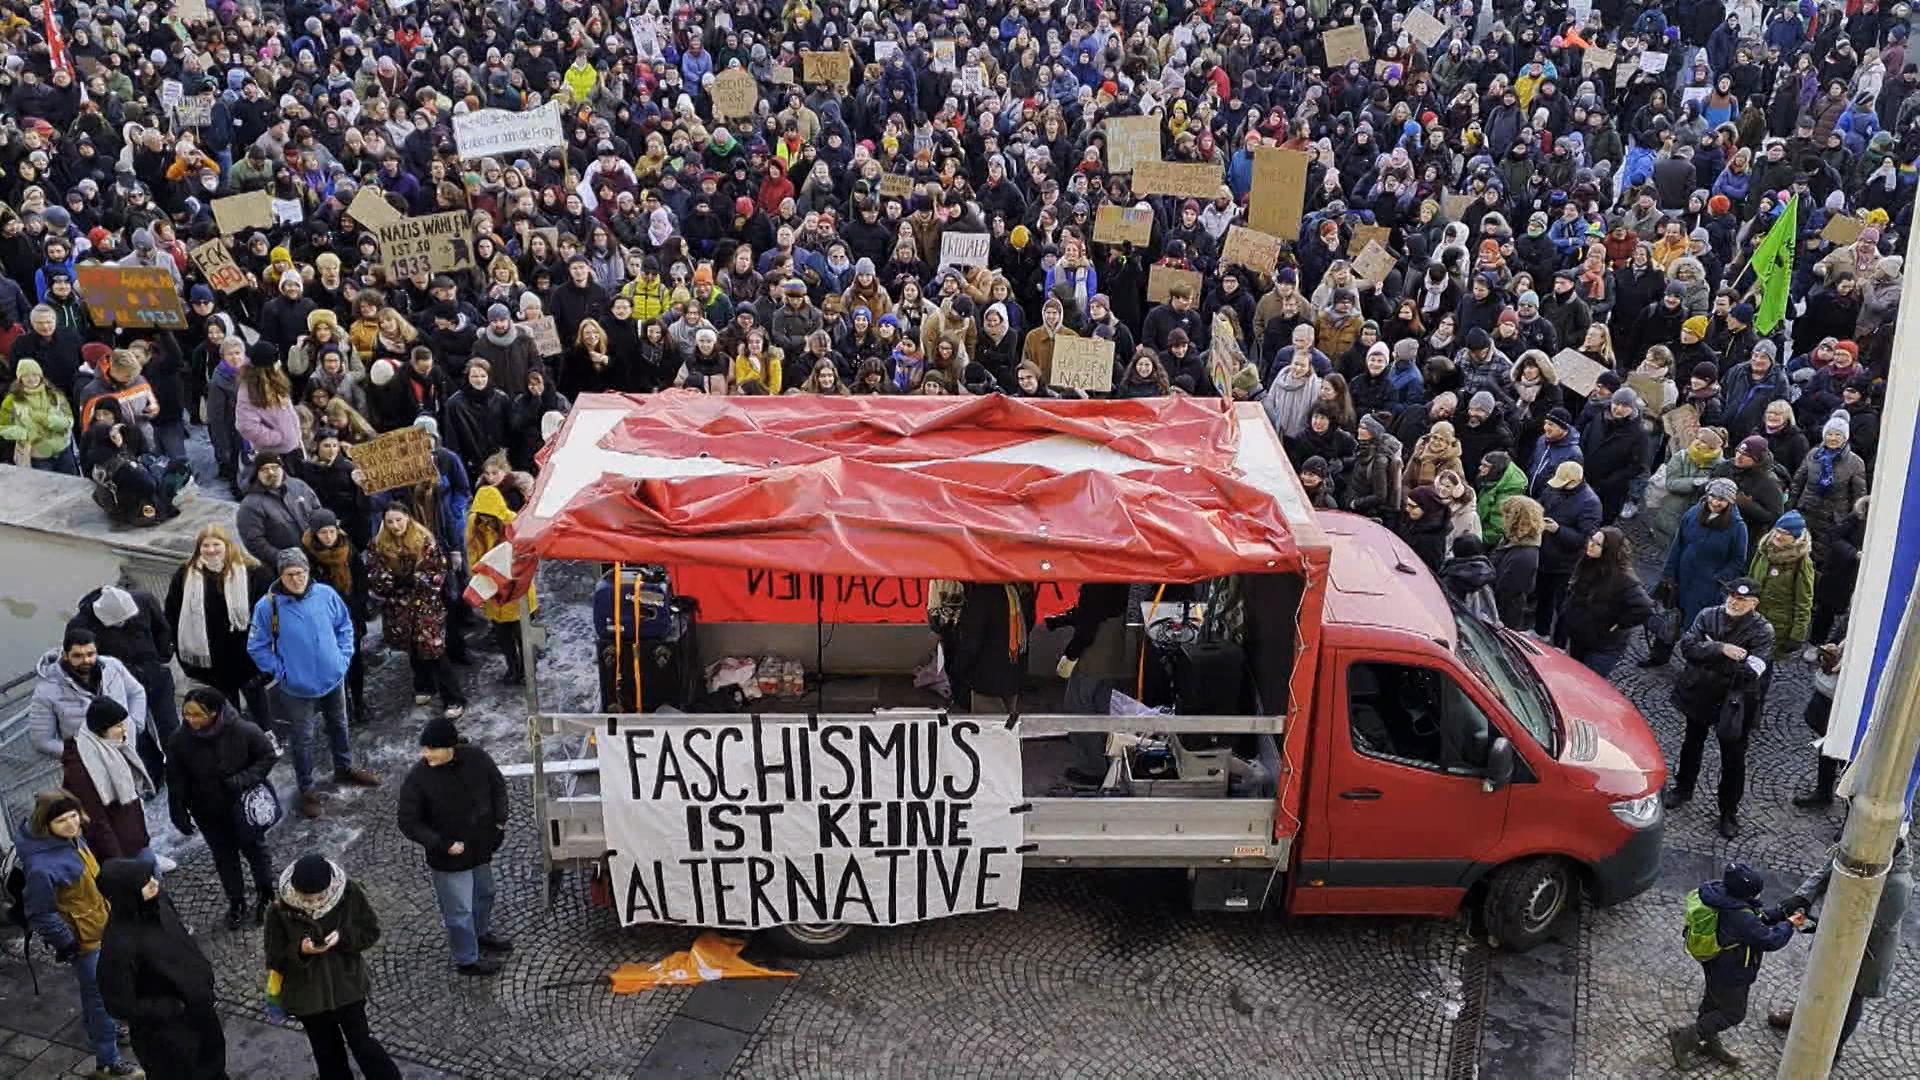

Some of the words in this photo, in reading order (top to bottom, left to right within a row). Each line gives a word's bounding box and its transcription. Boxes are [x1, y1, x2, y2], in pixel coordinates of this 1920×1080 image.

[380, 221, 420, 242] NAZIS
[195, 241, 229, 271] FCK
[392, 243, 411, 256] IST
[416, 240, 430, 253] SO
[391, 255, 431, 277] 1933
[1059, 370, 1105, 388] NAZIS
[624, 721, 981, 801] FASCHISMUS
[686, 803, 784, 852] IST
[818, 800, 973, 848] KEINE
[625, 846, 1008, 926] ALTERNATIVE
